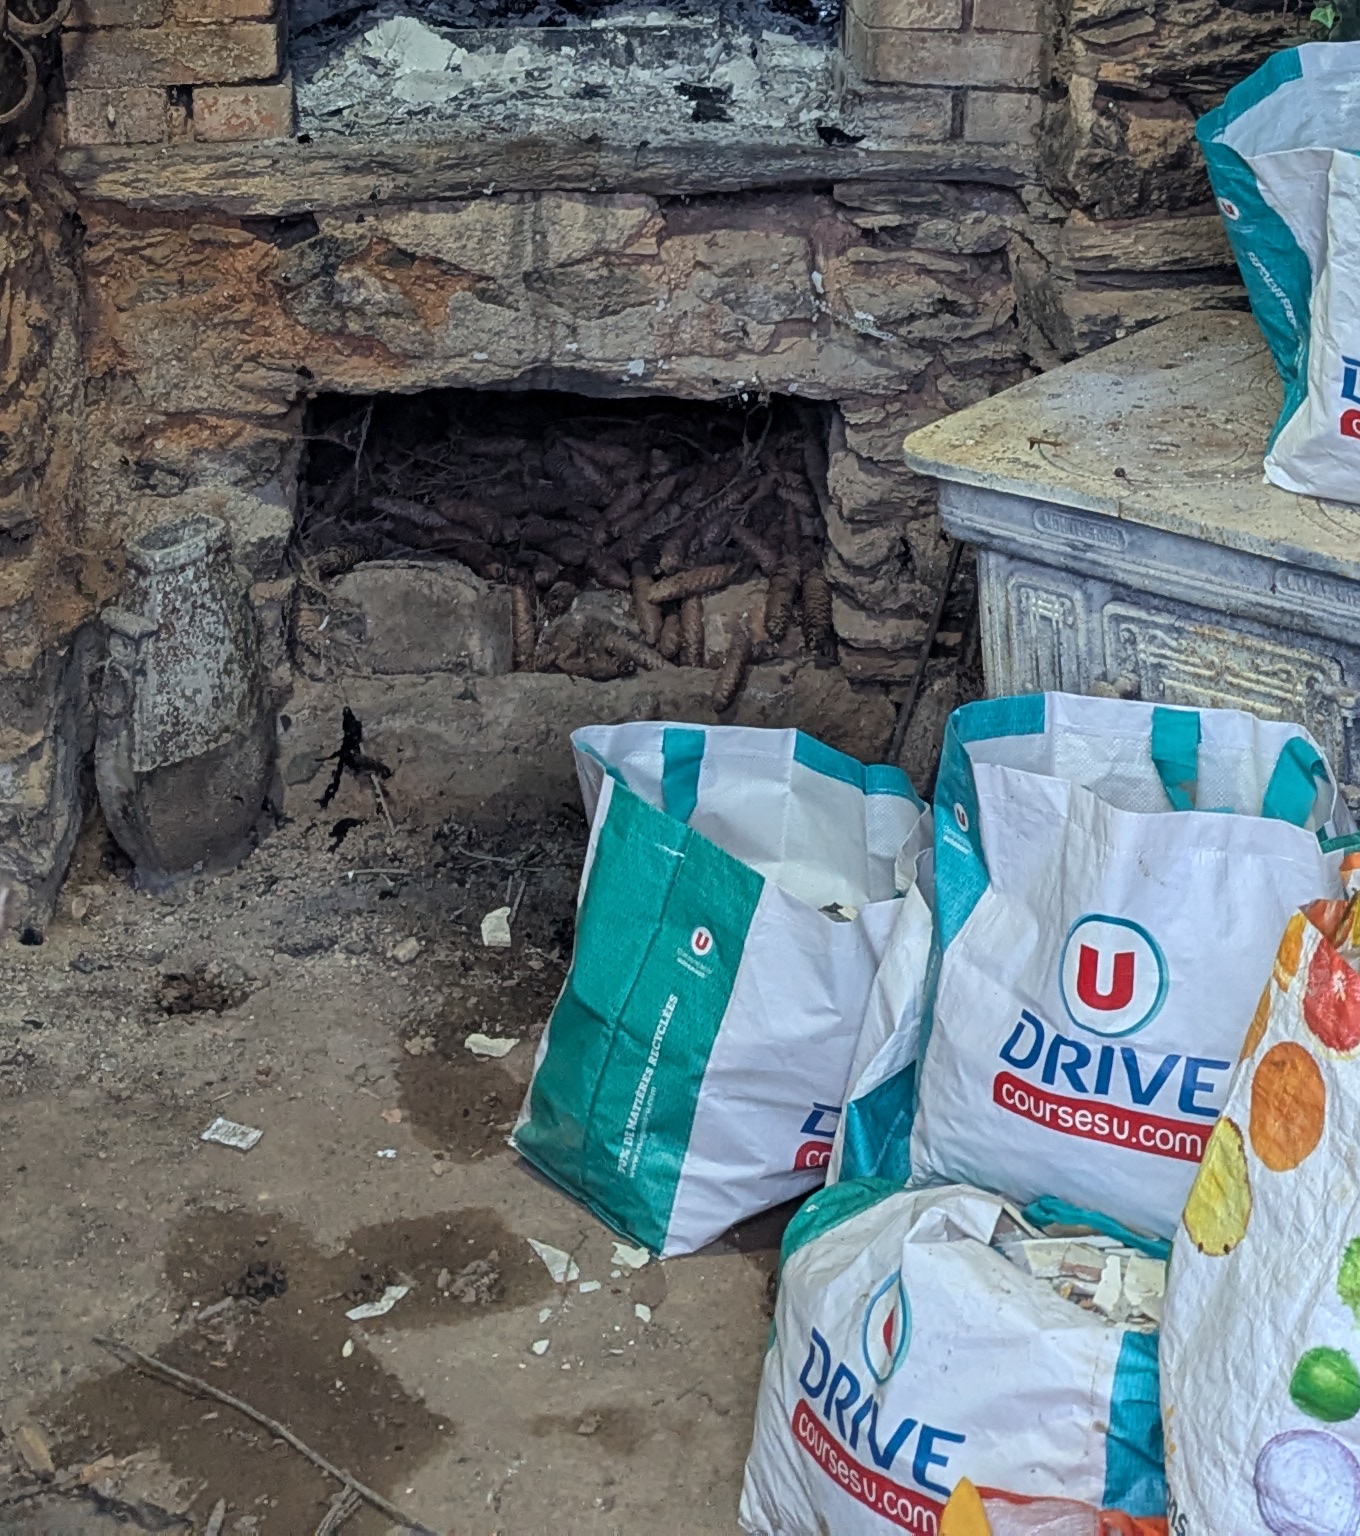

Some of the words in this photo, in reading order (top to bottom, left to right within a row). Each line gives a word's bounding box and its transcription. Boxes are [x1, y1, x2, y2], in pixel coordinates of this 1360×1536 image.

[695, 931, 710, 951] U
[1077, 944, 1135, 1011] U
[648, 993, 678, 1067] RECYCLÉES
[998, 1008, 1231, 1118] DRIVE
[1002, 1083, 1202, 1157] coursesu.com
[799, 1325, 967, 1498] DRIVE
[798, 1412, 939, 1536] coursesu.com
